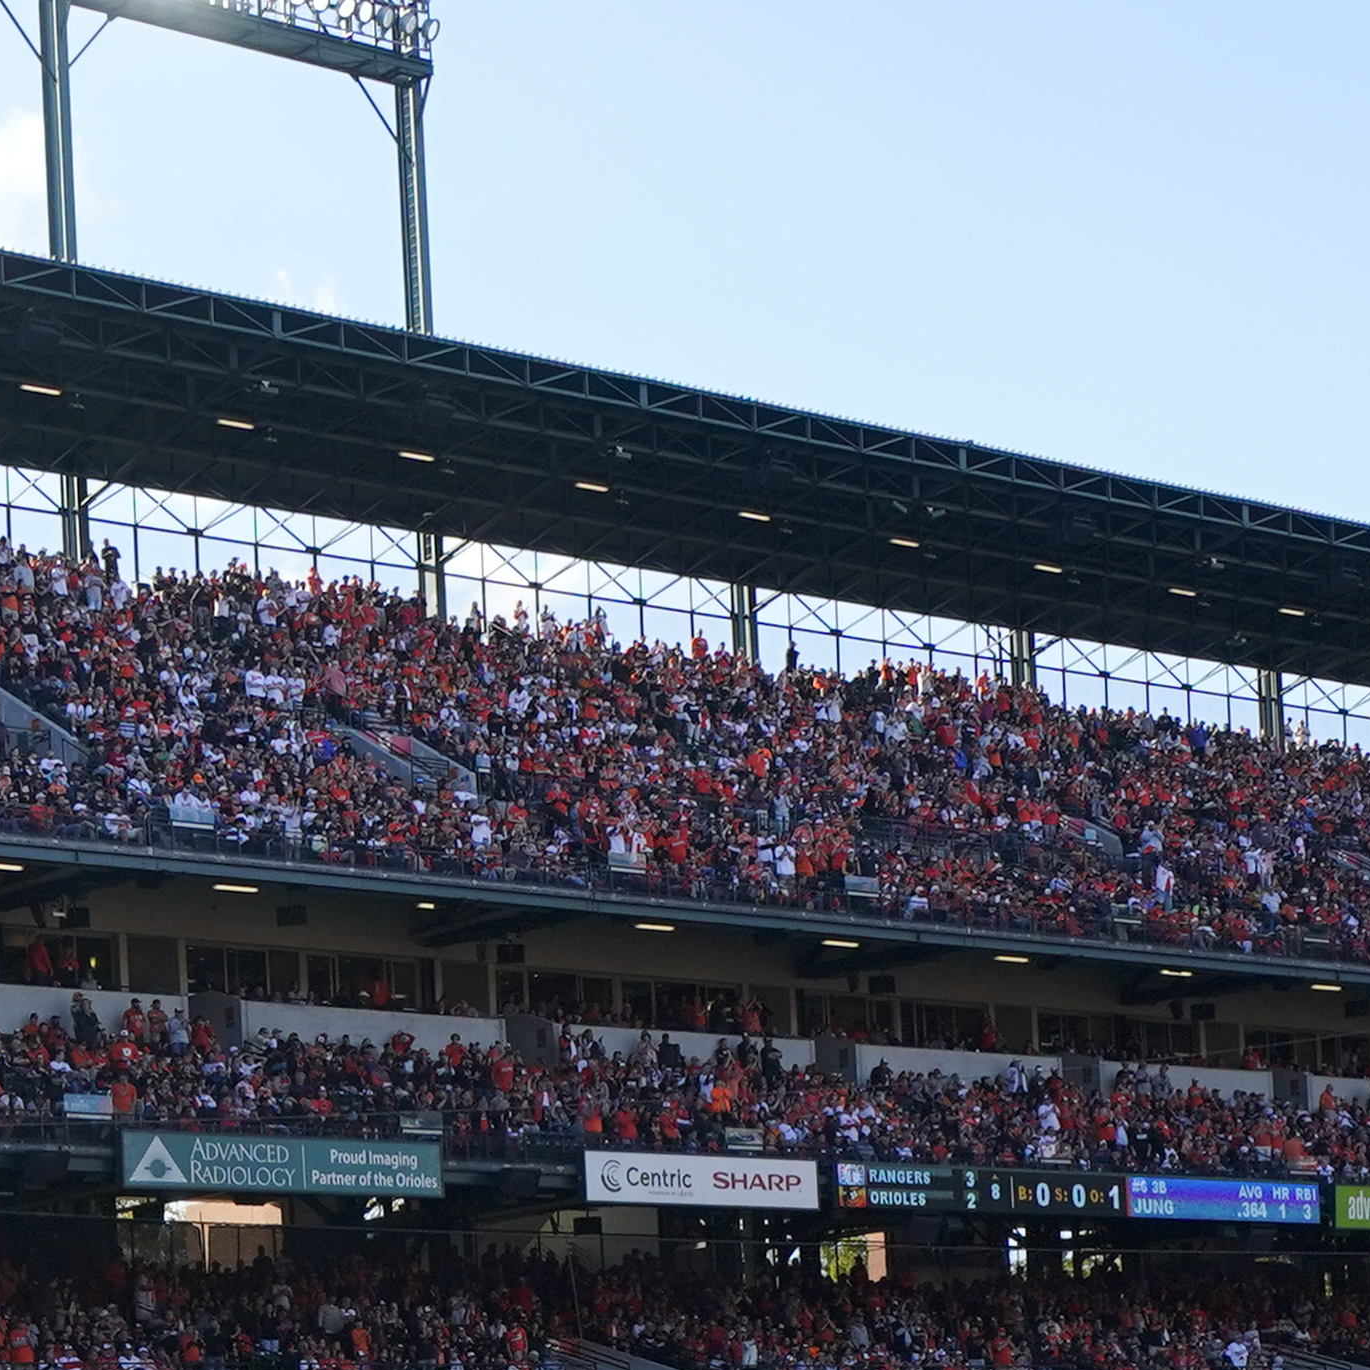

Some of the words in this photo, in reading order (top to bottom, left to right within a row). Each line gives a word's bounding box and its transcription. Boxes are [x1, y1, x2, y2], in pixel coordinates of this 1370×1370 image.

[190, 1136, 290, 1164] ADVANCED
[330, 1148, 366, 1165] Proud
[369, 1149, 418, 1171] Imaging
[190, 1160, 296, 1188] RADIOLOGY
[311, 1168, 358, 1185] Partner
[359, 1169, 374, 1186] of
[375, 1170, 394, 1187] the
[396, 1171, 438, 1189] Orioles
[626, 1166, 693, 1190] Centric
[713, 1171, 802, 1192] SHARP
[868, 1168, 932, 1186] RANGERS
[965, 1170, 976, 1188] 3
[869, 1190, 927, 1207] ORIOLES
[966, 1195, 977, 1210] 2
[990, 1182, 1001, 1200] 8
[1018, 1185, 1033, 1202] B:
[1036, 1181, 1051, 1208] 0
[1054, 1187, 1069, 1203] S:
[1071, 1183, 1087, 1209] 0
[1108, 1184, 1120, 1210] 1
[1132, 1178, 1148, 1194] #6
[1152, 1179, 1168, 1195] 3B
[1239, 1184, 1263, 1199] AVG
[1273, 1186, 1290, 1200] HR
[1296, 1187, 1317, 1202] RBI
[1133, 1199, 1174, 1216] JUNG
[1237, 1201, 1268, 1219] .364
[1279, 1203, 1287, 1219] 1
[1303, 1203, 1313, 1220] 3
